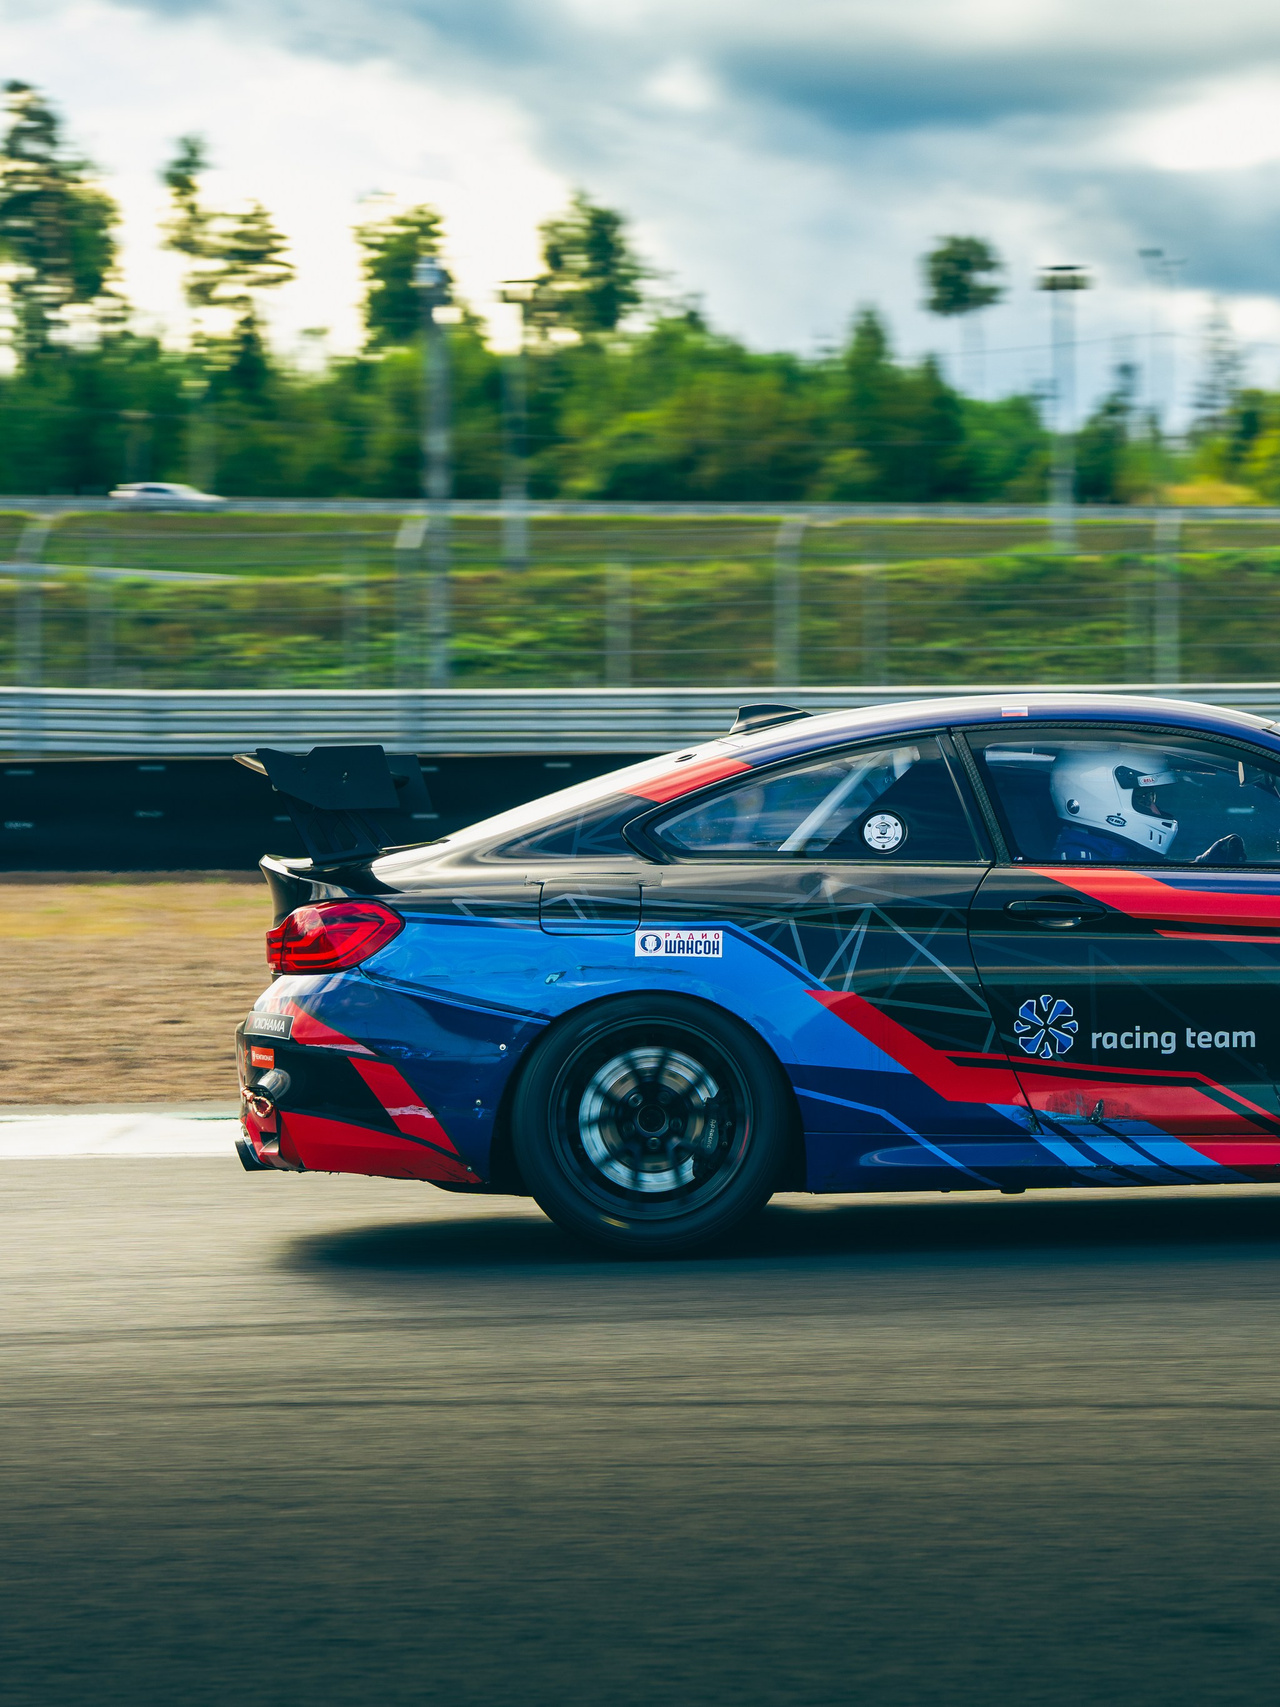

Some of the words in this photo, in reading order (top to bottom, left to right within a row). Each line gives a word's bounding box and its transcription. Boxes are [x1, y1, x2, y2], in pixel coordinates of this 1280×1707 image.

[664, 932, 720, 940] РАДИО
[664, 940, 720, 955] ШАНСОН
[1091, 1025, 1177, 1055] racing
[1185, 1027, 1256, 1049] team
